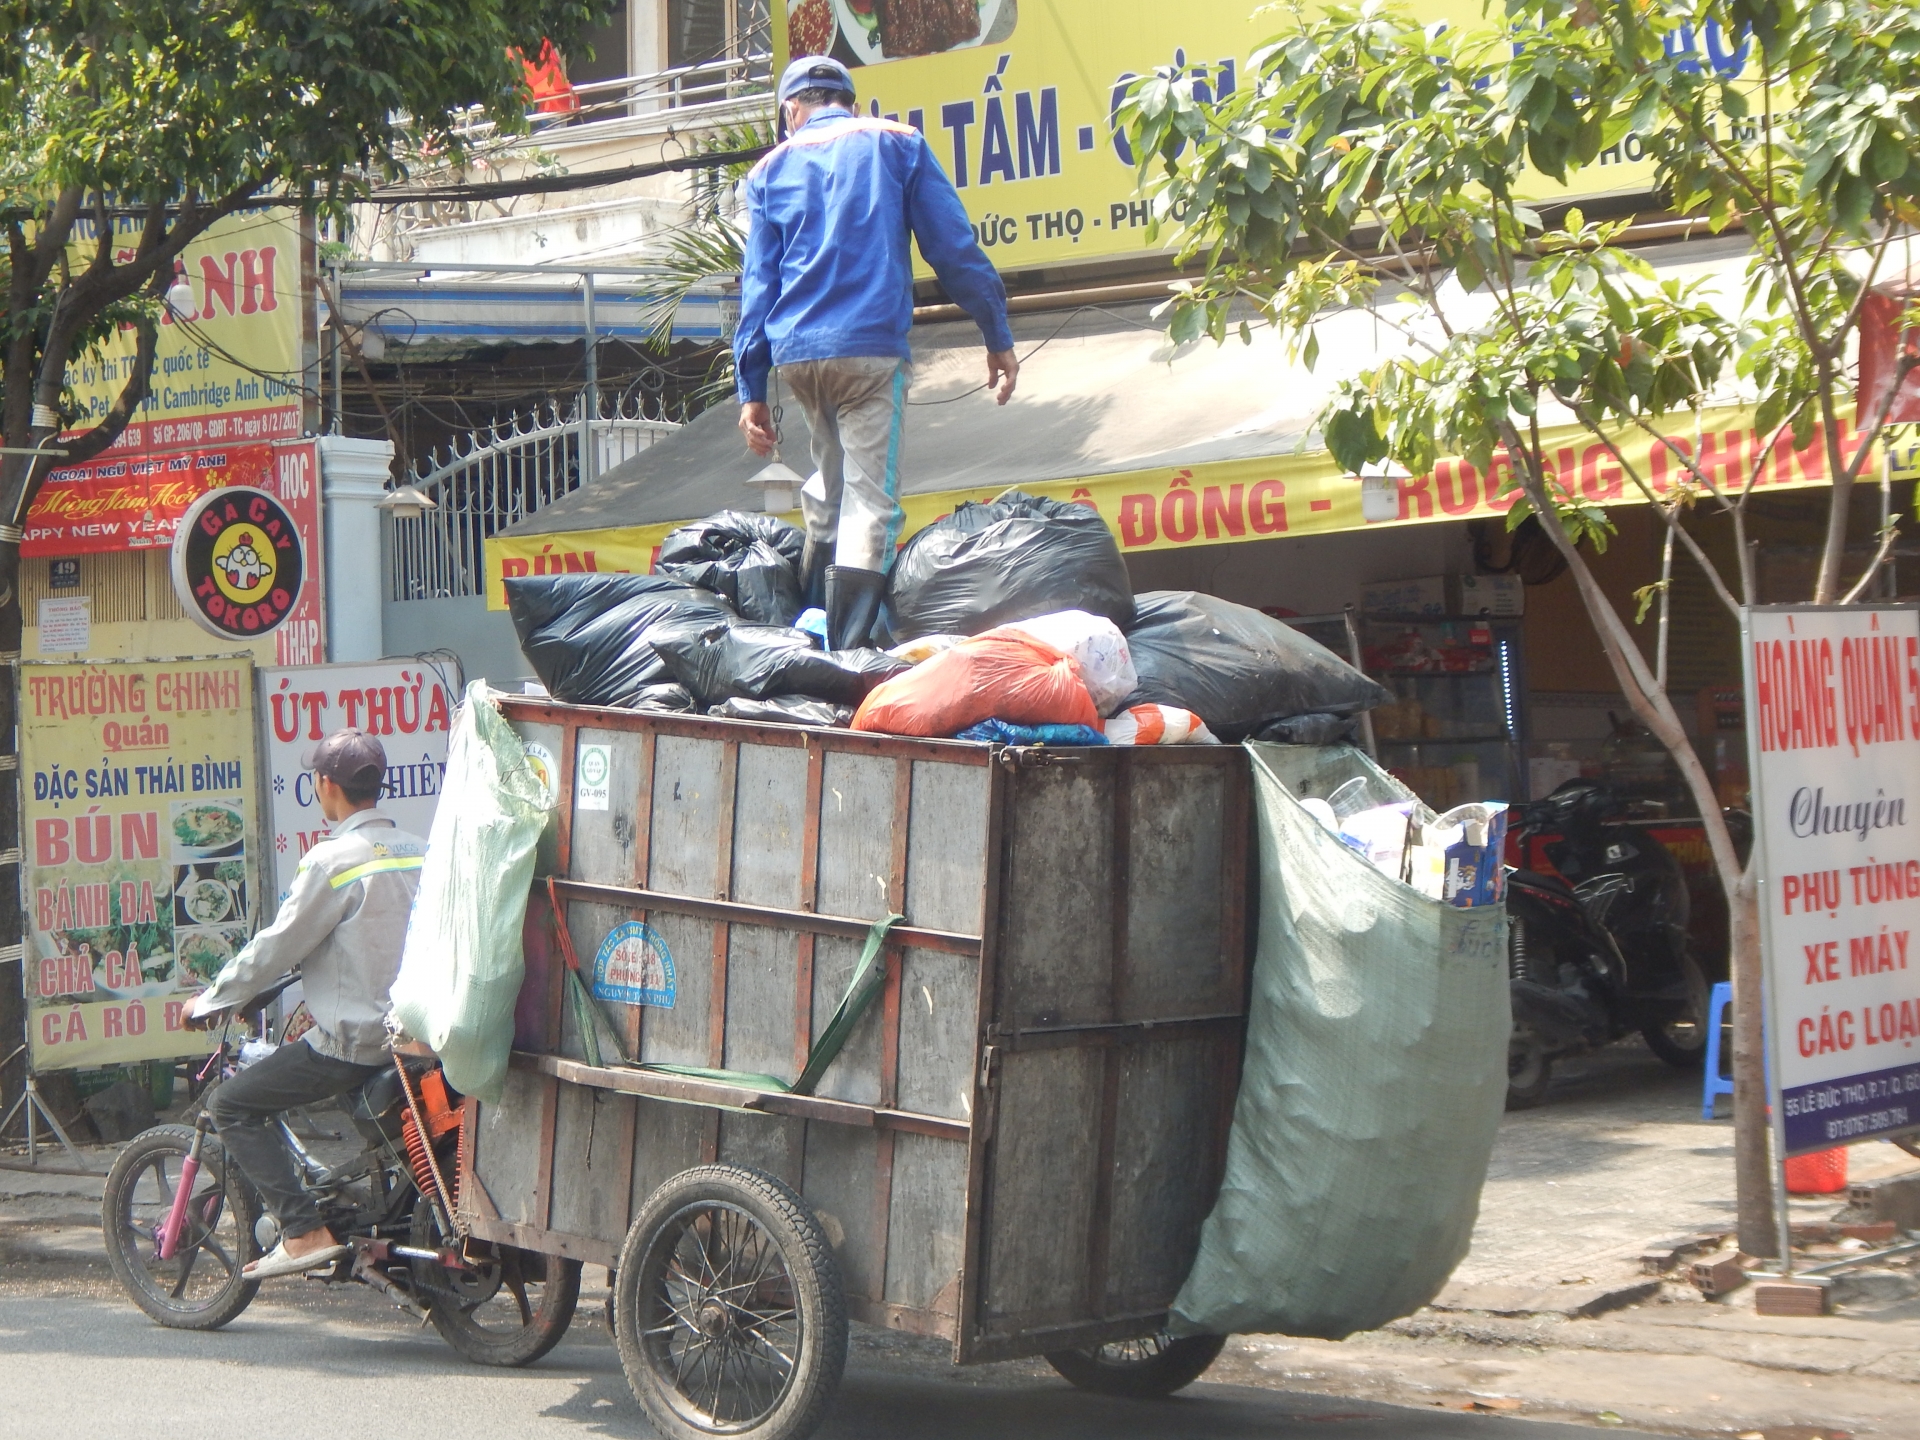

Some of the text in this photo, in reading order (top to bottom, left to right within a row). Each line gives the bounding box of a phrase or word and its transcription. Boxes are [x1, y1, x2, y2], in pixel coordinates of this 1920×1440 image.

[942, 54, 1061, 189] TẤM
[1026, 208, 1084, 243] THỌ
[163, 345, 193, 378] quốc
[163, 379, 231, 410] Cambridge
[235, 378, 259, 401] Anh
[263, 372, 297, 398] Quốc
[48, 454, 227, 482] NGOẠI NGỮ VIỆT MỸ ANH
[280, 452, 309, 508] HỌC
[21, 526, 63, 541] APPY
[71, 522, 121, 538] NEW
[201, 496, 291, 548] GÀ CAY
[1117, 470, 1288, 547] ĐỒNG
[54, 561, 76, 575] 49
[196, 575, 290, 630] TOKORO
[280, 601, 319, 665] THẤP
[29, 665, 241, 720] TRƯỜNG CHINH
[270, 670, 449, 743] ÚT THỪA
[1755, 614, 1839, 752] HOÀNG
[103, 714, 170, 752] Quán
[34, 754, 242, 809] ĐẶC SẢN THÁI BÌNH
[580, 787, 607, 799] GV-095
[35, 805, 159, 867] BÚN
[1789, 786, 1908, 843] Chuyên
[37, 877, 158, 932] BÁNH ĐA
[1781, 856, 1920, 919] PHỤ TÙNG
[39, 941, 143, 997] CHẢ CÁ
[1804, 925, 1911, 985] XE MÁY
[41, 1003, 88, 1046] CÁ
[103, 999, 147, 1039] RÔ
[1798, 999, 1920, 1058] CÁC LOẠI
[1801, 1089, 1816, 1113] LÊ
